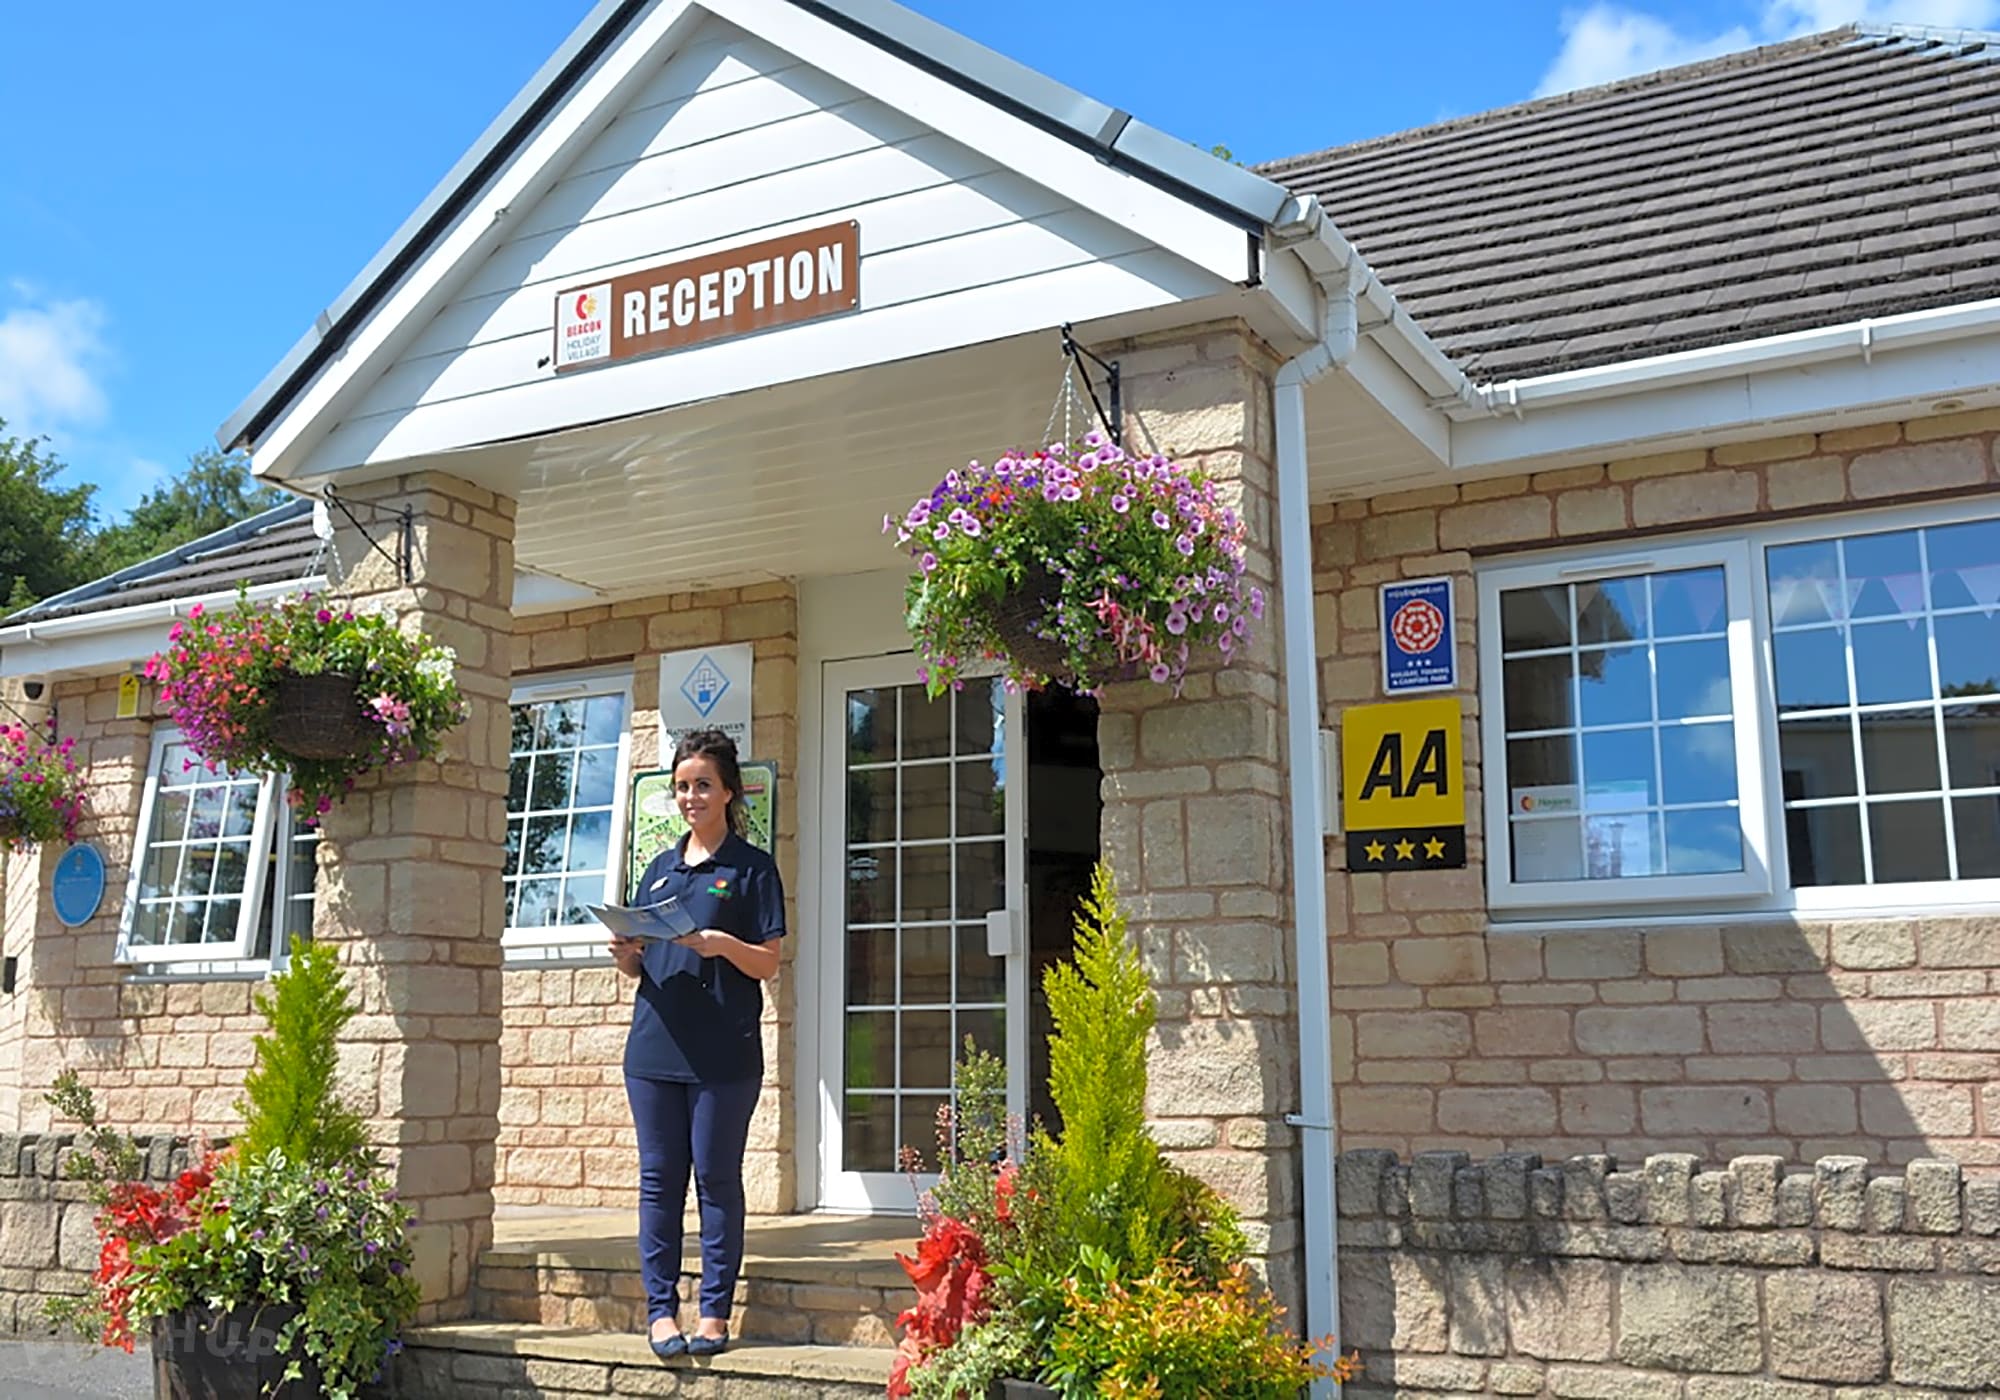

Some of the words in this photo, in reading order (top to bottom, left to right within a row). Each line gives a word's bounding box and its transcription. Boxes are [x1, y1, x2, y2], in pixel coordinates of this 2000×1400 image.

[623, 242, 843, 339] RECEPTION
[566, 320, 602, 338] BEACON
[567, 335, 601, 350] HOLIDAY
[567, 346, 601, 360] VILLAGE
[1359, 729, 1449, 801] AA
